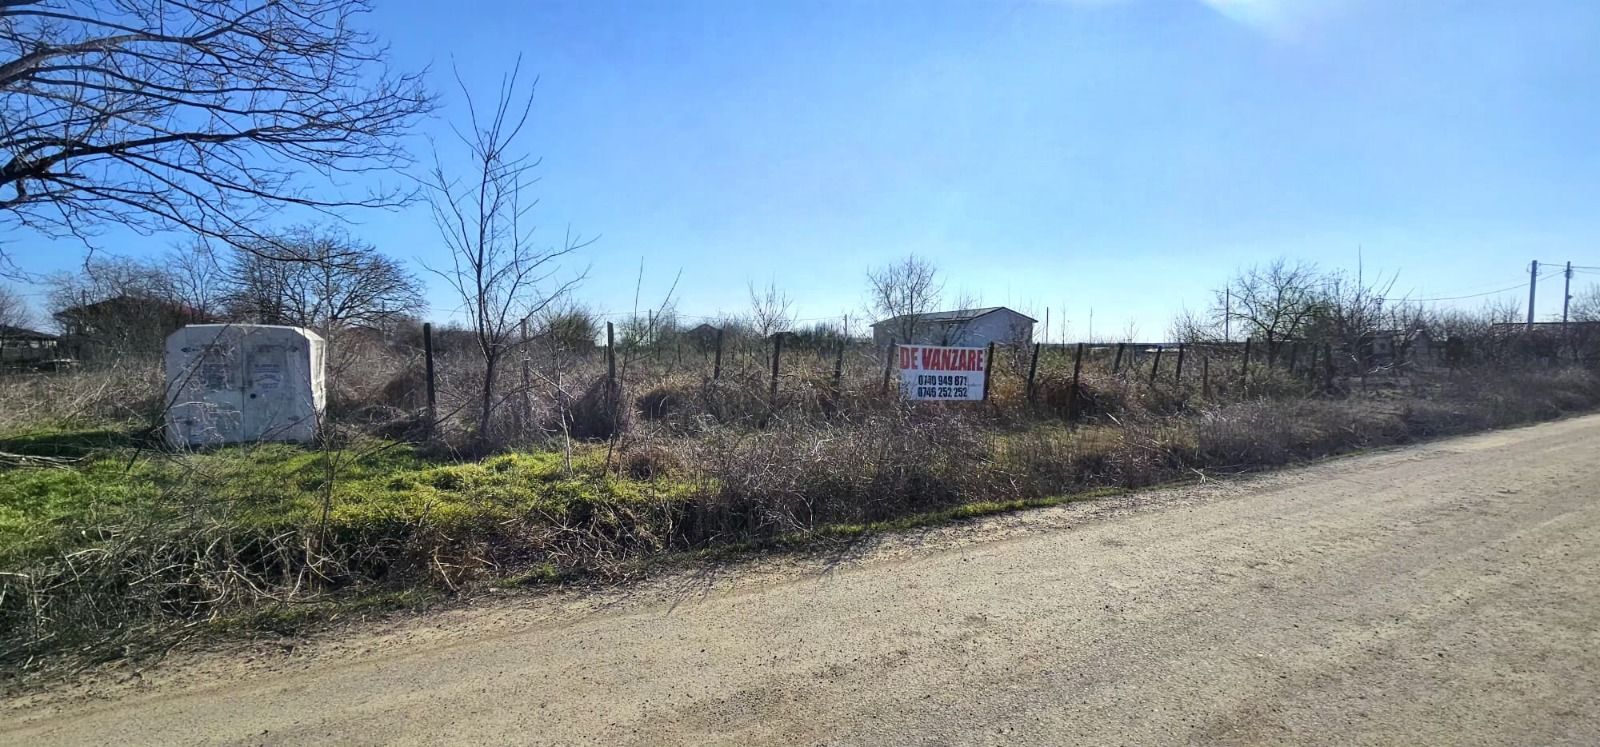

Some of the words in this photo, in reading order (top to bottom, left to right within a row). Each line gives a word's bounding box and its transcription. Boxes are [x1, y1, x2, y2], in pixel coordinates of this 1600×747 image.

[900, 346, 919, 370] DE
[921, 347, 983, 371] VANZARE
[937, 375, 953, 386] 949
[954, 376, 967, 386] 871
[917, 387, 937, 398] 0746
[937, 387, 953, 398] 252
[953, 387, 968, 398] 252
